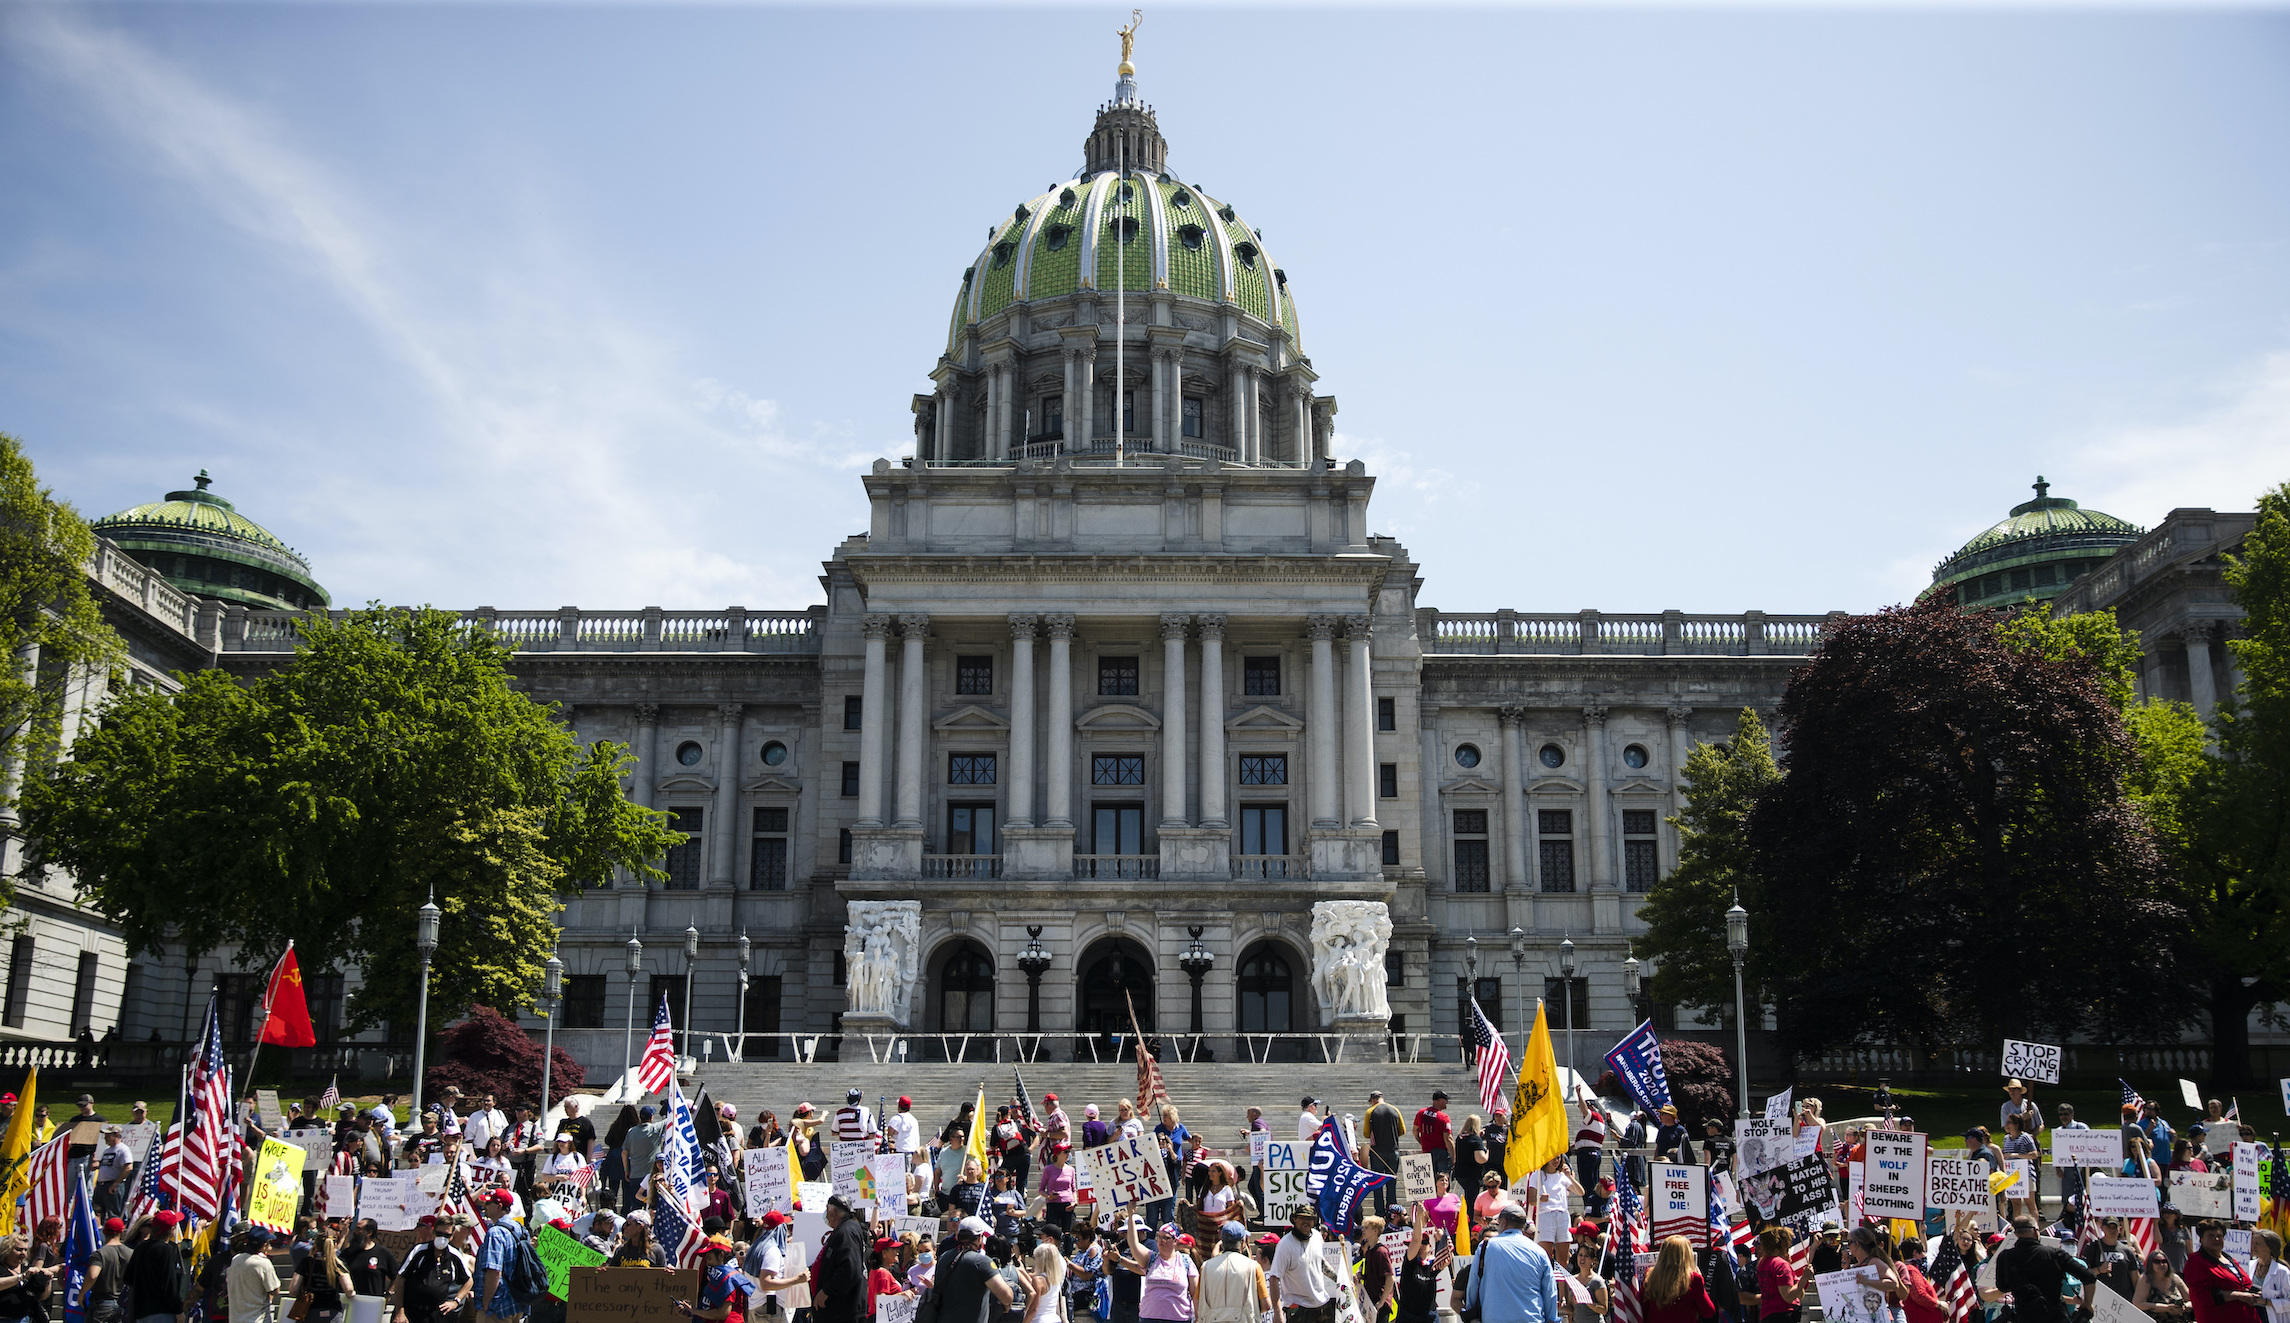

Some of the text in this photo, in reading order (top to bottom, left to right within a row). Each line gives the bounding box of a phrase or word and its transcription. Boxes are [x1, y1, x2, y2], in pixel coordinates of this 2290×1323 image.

[2009, 1043, 2057, 1059] STOP
[2004, 1064, 2058, 1082] WOLF!
[1623, 1065, 1645, 1097] LIBERALS
[1639, 1070, 1659, 1096] 2020
[1744, 1128, 1769, 1137] STOP
[1773, 1127, 1791, 1136] THE
[1871, 1132, 1913, 1143] BEWARE
[264, 1143, 288, 1157] WOLF
[1096, 1139, 1142, 1166] FEAR
[1874, 1146, 1912, 1156] OF THE
[2087, 1145, 2107, 1153] WOLF
[752, 1153, 769, 1163] ALL
[1269, 1144, 1295, 1170] PA
[1787, 1159, 1805, 1172] SET
[1812, 1154, 1820, 1162] A
[749, 1163, 785, 1176] Business
[1111, 1158, 1156, 1186] IS A
[1413, 1163, 1431, 1173] DON'T
[1879, 1160, 1908, 1170] WOLF
[1931, 1160, 1980, 1176] FREE TO
[1666, 1169, 1688, 1178] LIVE
[1790, 1164, 1824, 1183] MATCH
[1888, 1172, 1899, 1180] IN
[256, 1182, 268, 1199] IS
[1269, 1172, 1304, 1194] SIC
[1665, 1181, 1690, 1190] FREE
[1792, 1175, 1828, 1195] TO HIS
[1869, 1184, 1909, 1194] SHEEPS
[1931, 1177, 1988, 1192] BREATHE
[2191, 1180, 2212, 1188] WOLF
[1111, 1177, 1164, 1207] LIAR
[1286, 1194, 1298, 1202] OF
[1408, 1187, 1434, 1195] THREATS
[1511, 1188, 1526, 1196] HEAV
[1671, 1191, 1685, 1199] OR
[1802, 1188, 1827, 1204] ASS!
[1931, 1191, 1989, 1206] GOD'S AIR
[268, 1198, 294, 1223] VIRUS!
[1669, 1201, 1689, 1210] DIE!
[1865, 1197, 1914, 1209] CLOTHING
[1780, 1200, 1836, 1226] REOPEN PA
[542, 1226, 574, 1252] ENOUGH
[574, 1246, 586, 1257] OF
[1385, 1234, 1399, 1242] MY
[581, 1276, 610, 1294] The
[618, 1280, 643, 1298] only
[653, 1278, 687, 1297] thing
[574, 1300, 639, 1317] necessary
[644, 1300, 662, 1314] for
[2111, 1299, 2125, 1316] BE
